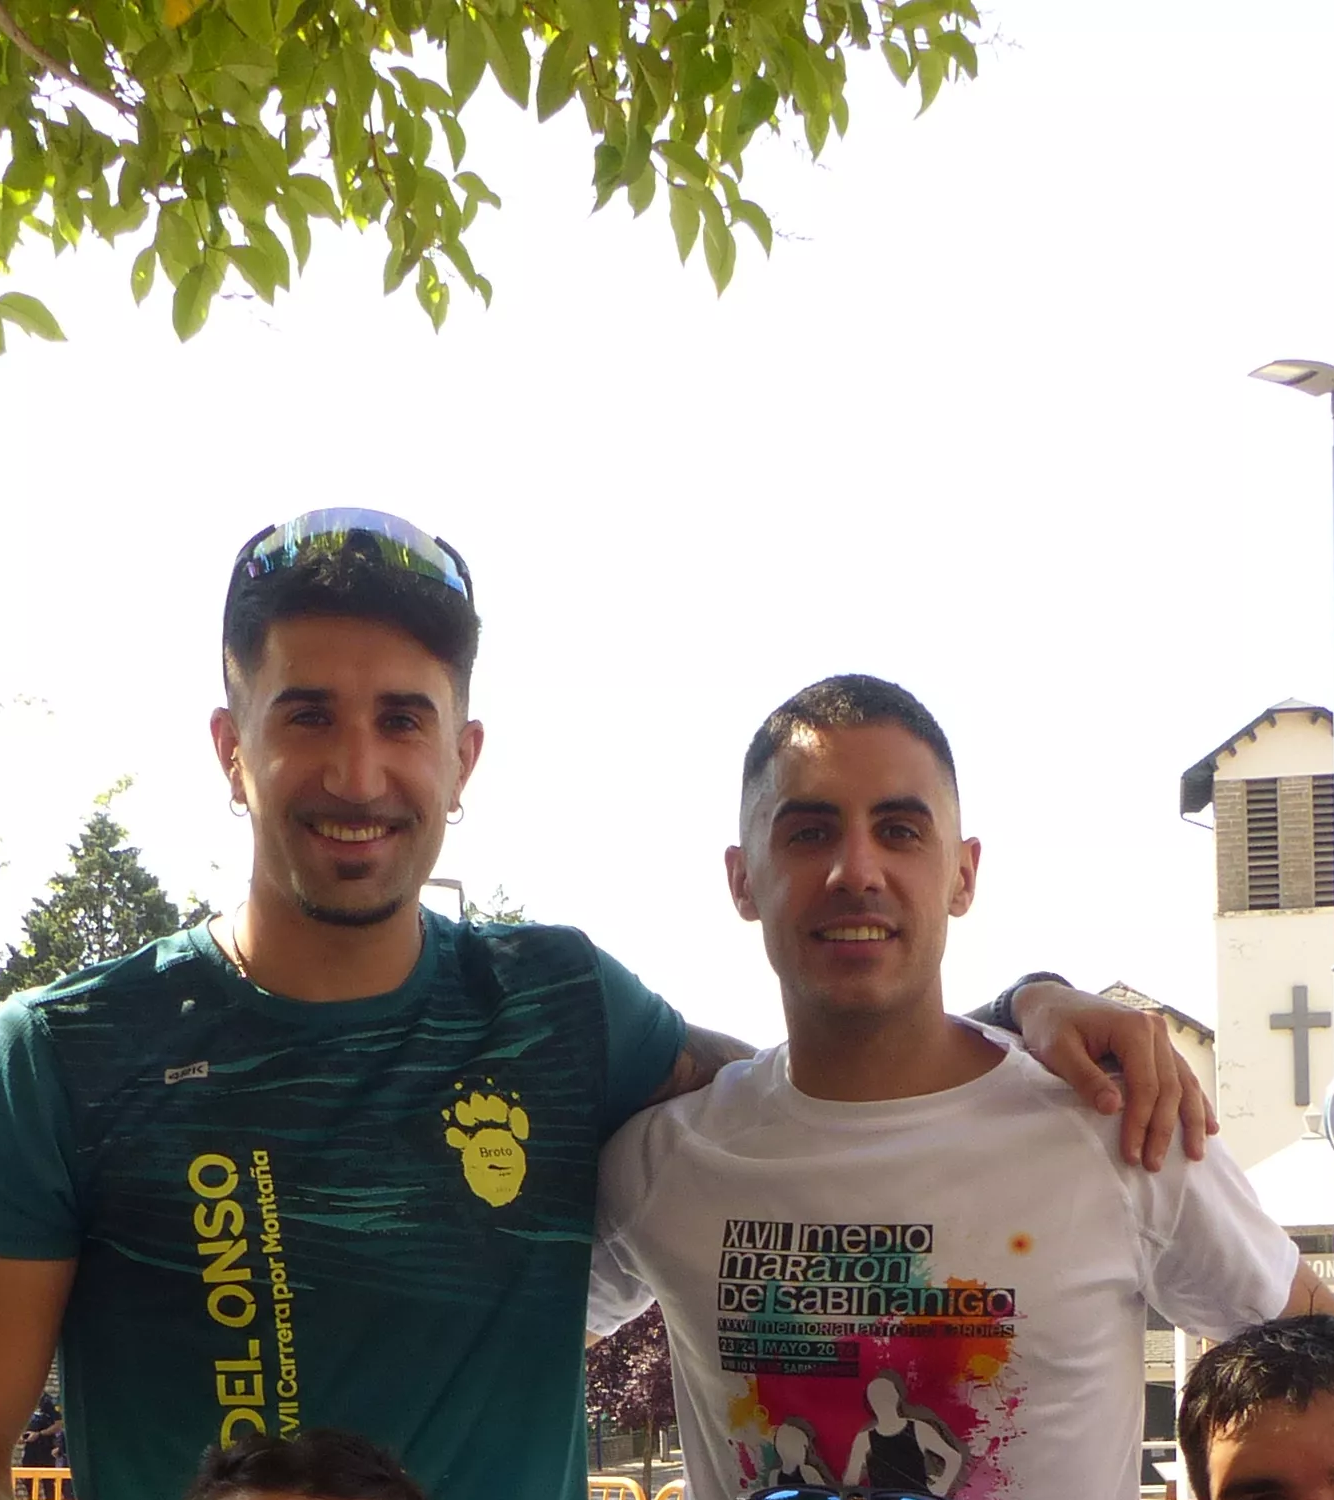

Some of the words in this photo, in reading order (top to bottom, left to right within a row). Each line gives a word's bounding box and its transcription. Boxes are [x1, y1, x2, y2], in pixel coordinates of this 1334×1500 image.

[187, 1153, 257, 1329] ONSO
[249, 1149, 283, 1253] Montaña
[266, 1256, 294, 1301] por
[273, 1303, 299, 1399] Carrera
[764, 1341, 811, 1355] MAYO
